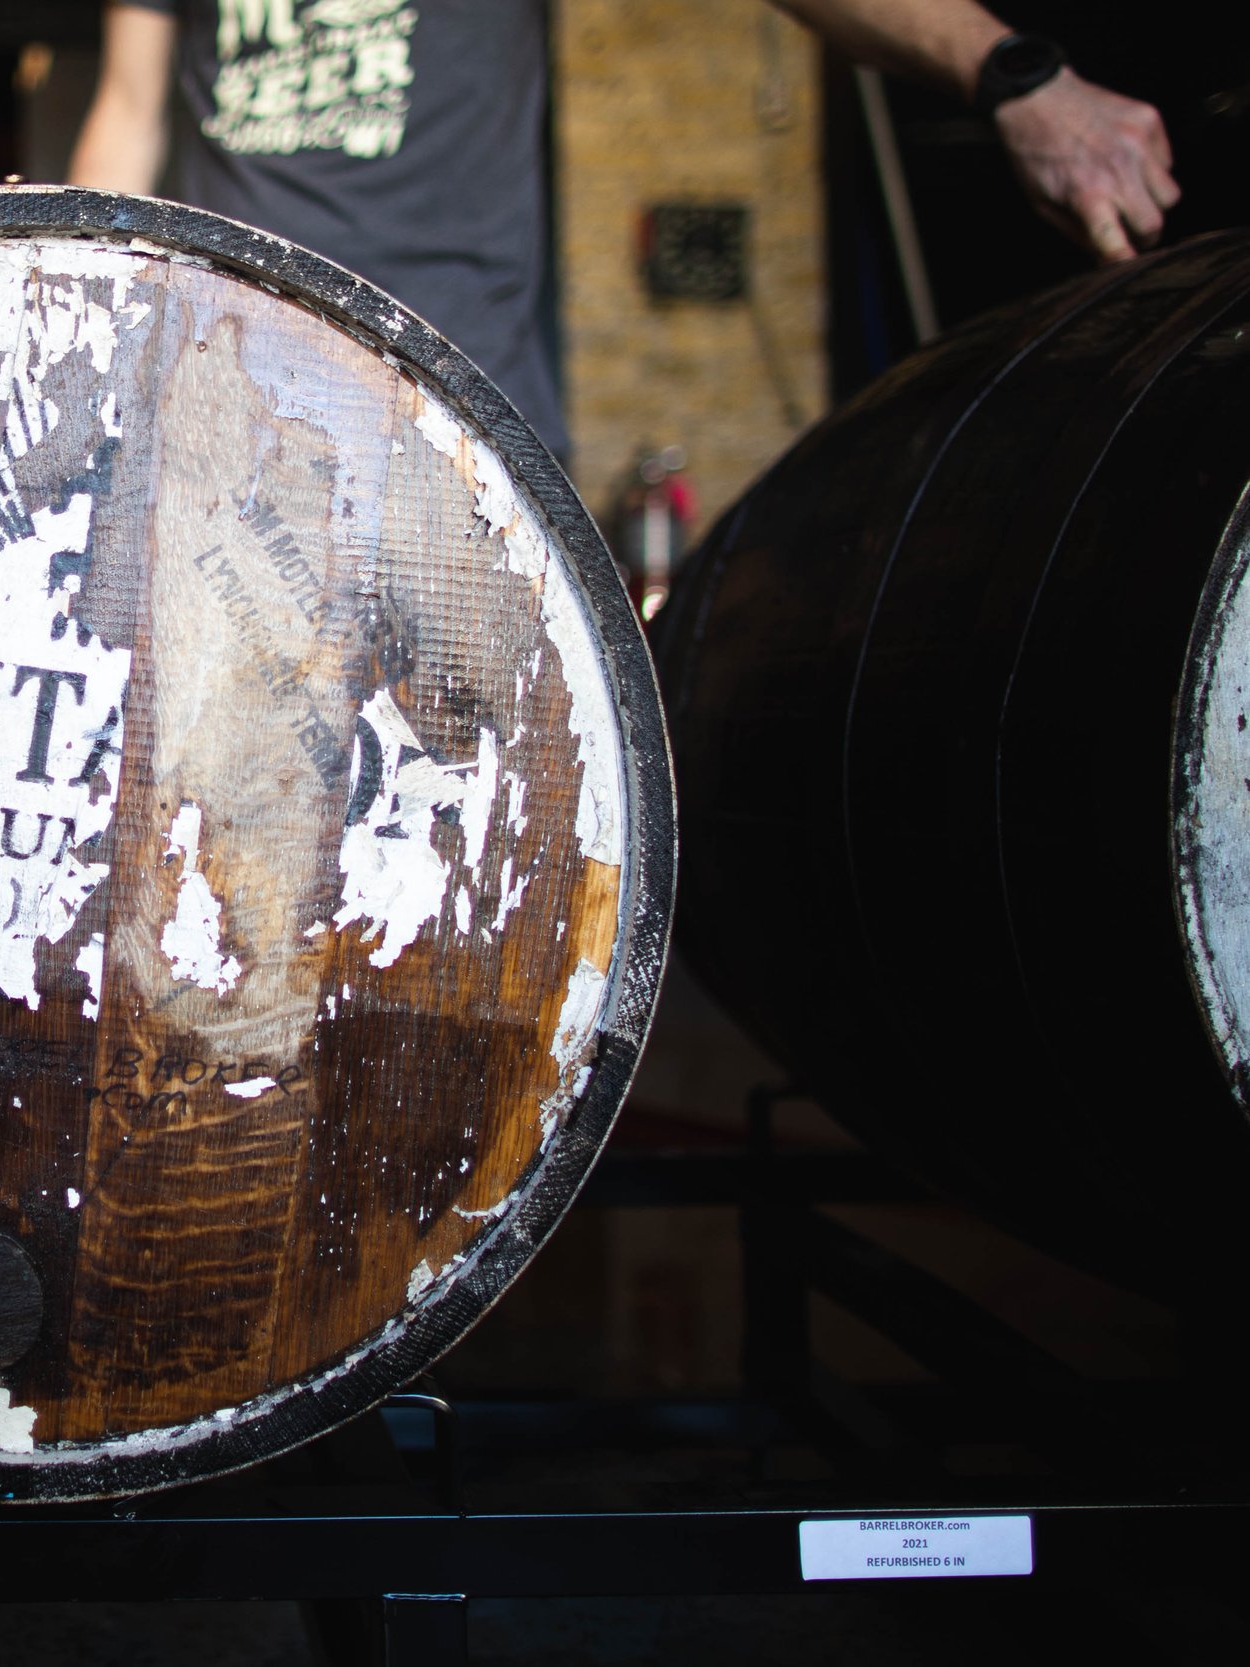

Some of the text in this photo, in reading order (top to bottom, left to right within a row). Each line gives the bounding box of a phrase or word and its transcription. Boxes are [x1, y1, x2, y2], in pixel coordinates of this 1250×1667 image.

[859, 1520, 970, 1532] BARRELBROKER.com
[902, 1538, 928, 1549] 2021
[866, 1556, 965, 1567] REFURBISHED 6 IN
